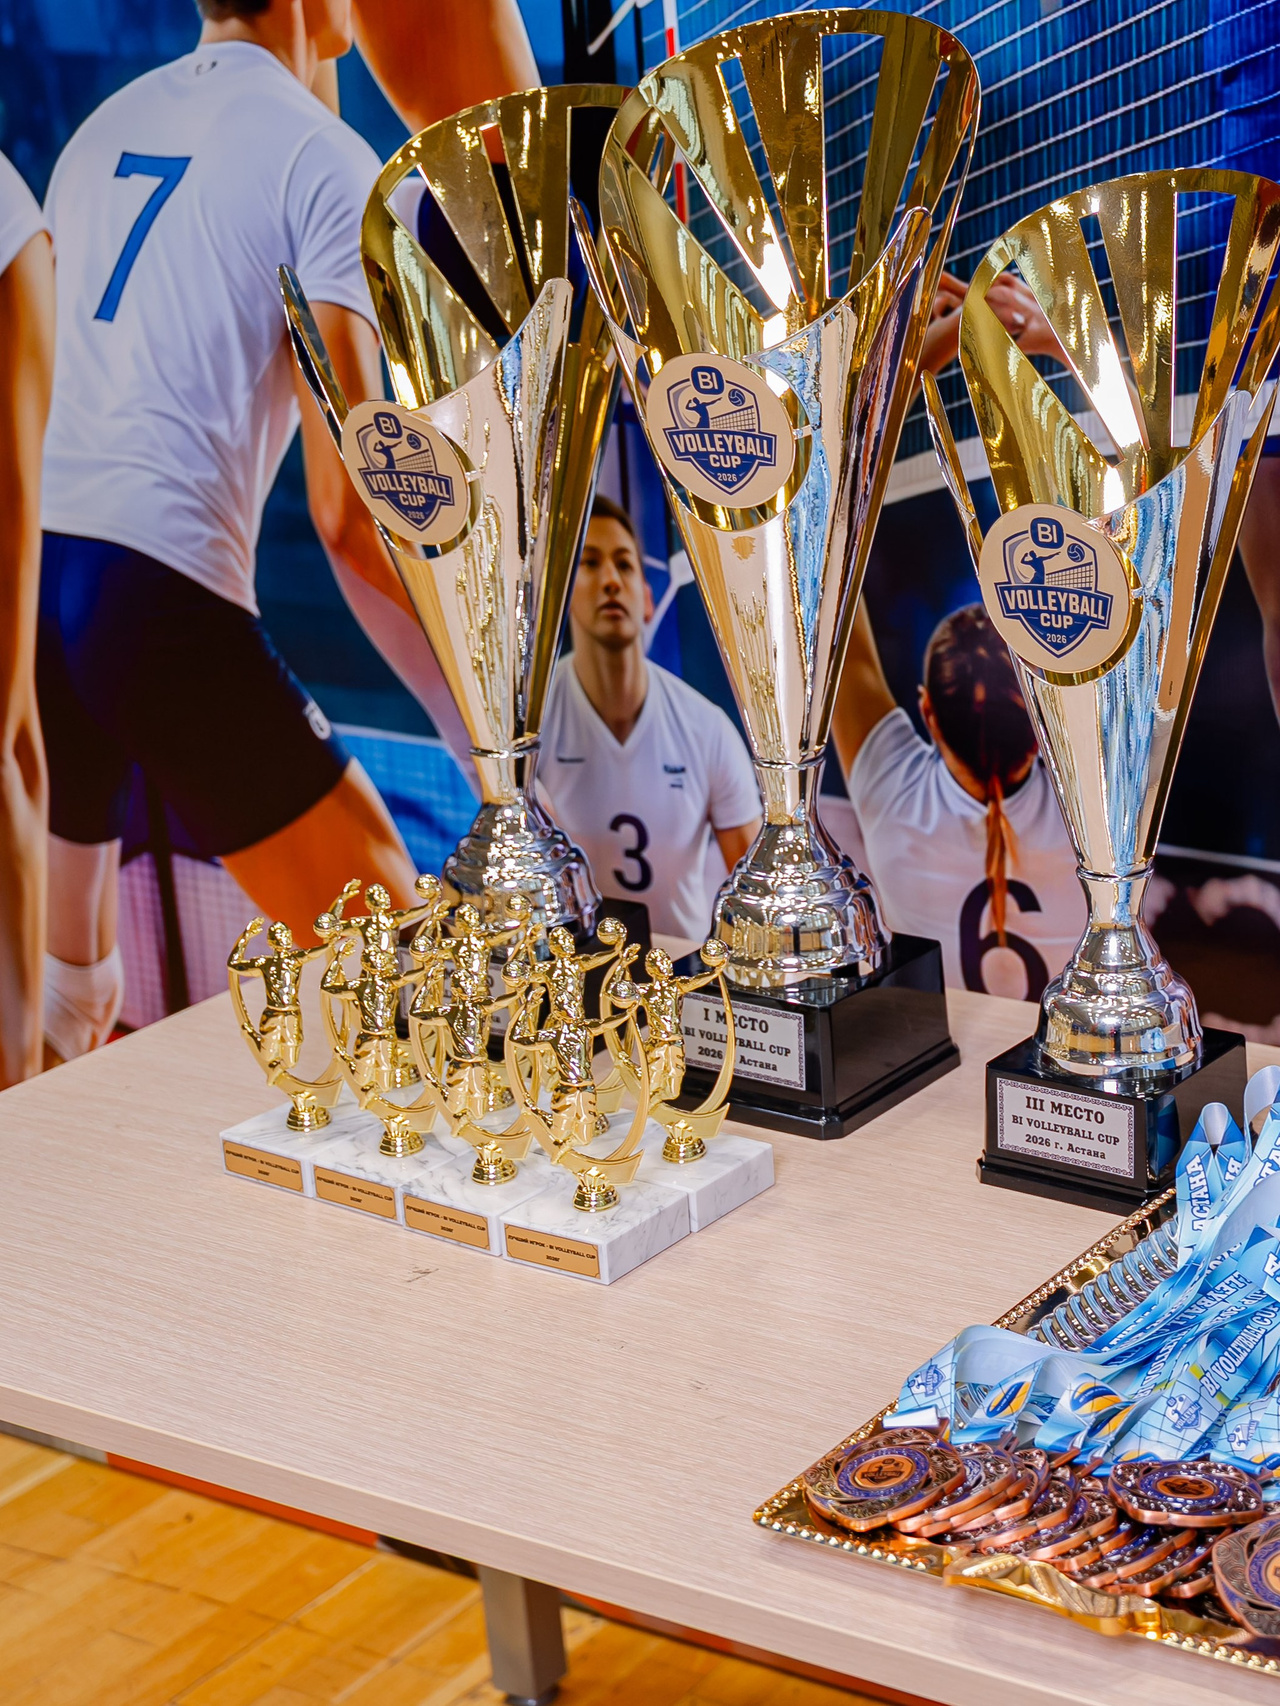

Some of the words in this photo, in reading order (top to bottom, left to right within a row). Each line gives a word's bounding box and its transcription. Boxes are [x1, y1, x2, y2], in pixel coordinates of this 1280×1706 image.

[93, 151, 193, 323] 7
[697, 371, 719, 390] BI
[378, 417, 398, 434] BI
[672, 433, 771, 459] VOLLEYBALL
[709, 454, 741, 469] CUP
[366, 473, 450, 498] VOLLEYBALL
[717, 473, 738, 482] 2026
[399, 493, 426, 507] CUP
[1037, 522, 1058, 544] BI
[1003, 589, 1105, 620] VOLLEYBALL
[1040, 613, 1074, 629] CUP
[1046, 633, 1067, 644] 2026
[609, 813, 652, 892] 3
[959, 878, 1050, 1004] 6
[703, 1008, 710, 1021] I
[684, 1026, 696, 1037] BI
[699, 1029, 766, 1052] VOLLBALL
[769, 1044, 791, 1057] CUP
[698, 1046, 723, 1060] 2026
[739, 1055, 778, 1072] Астана
[1025, 1096, 1045, 1112] III
[1050, 1101, 1105, 1125] МЕСТО
[1012, 1114, 1023, 1126] BI
[1026, 1118, 1094, 1141] VOLLEYBALL
[1097, 1133, 1120, 1146] CUP
[1025, 1134, 1051, 1147] 2026
[1054, 1141, 1063, 1150] г.
[1067, 1143, 1106, 1160] Астана
[1224, 1156, 1242, 1183] BI
[1200, 1371, 1221, 1398] BI
[1211, 1320, 1268, 1382] VOLLEYBALL
[1174, 1402, 1200, 1430] VOLLEYBALL
